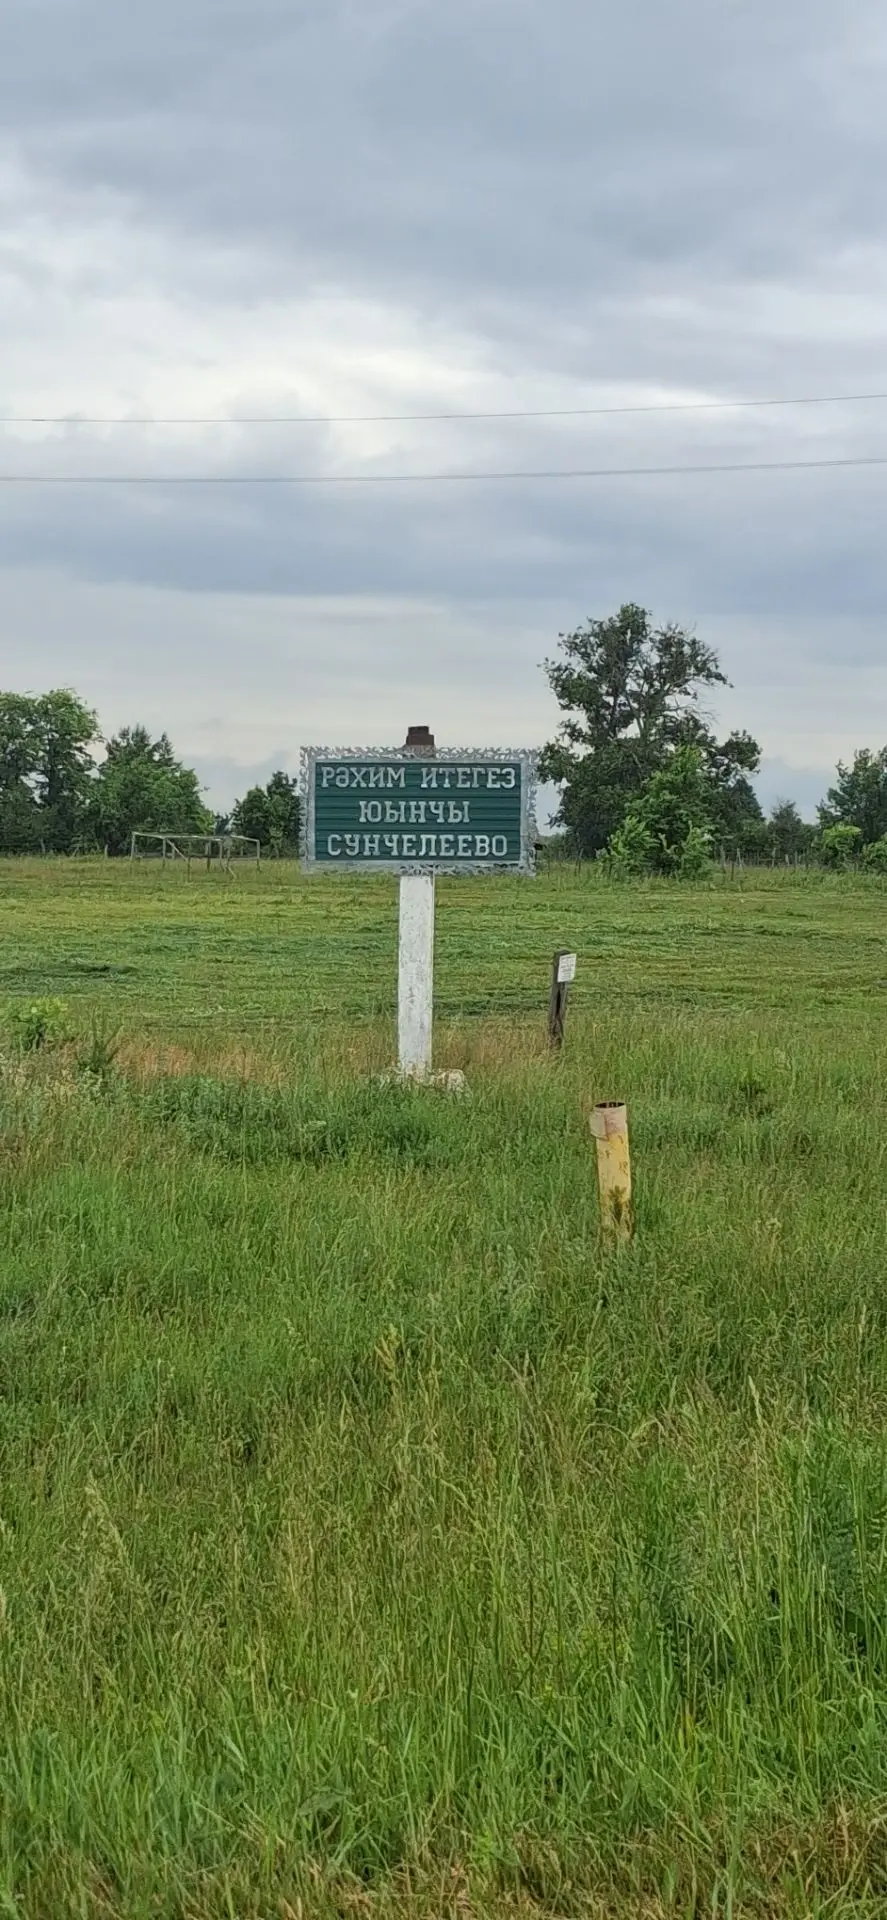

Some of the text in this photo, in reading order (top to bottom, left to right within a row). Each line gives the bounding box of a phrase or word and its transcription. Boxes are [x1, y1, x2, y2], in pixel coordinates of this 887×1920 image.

[321, 766, 516, 789] РӘХИМ ИТЕГЕЗ
[358, 800, 470, 823] ЮЫНЧЫ
[327, 834, 508, 857] СУНЧЕЛЕЕВО
